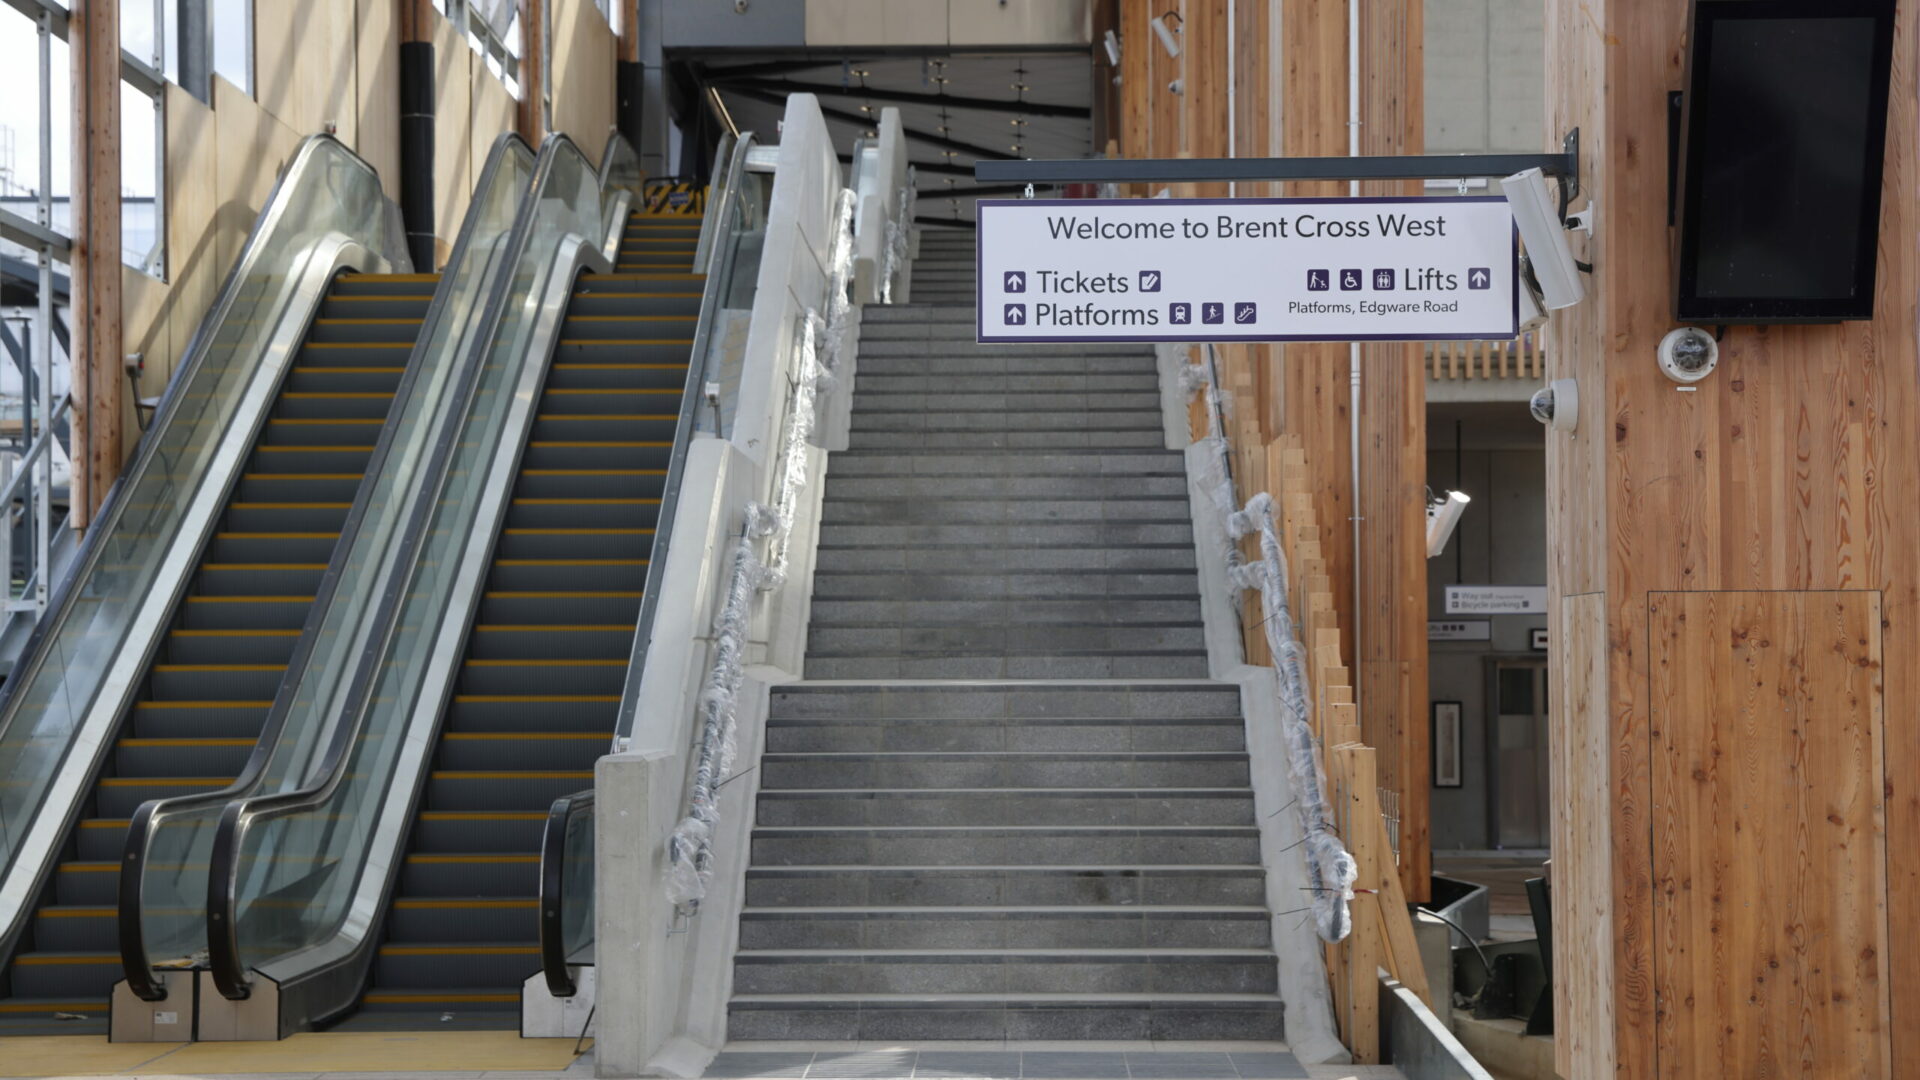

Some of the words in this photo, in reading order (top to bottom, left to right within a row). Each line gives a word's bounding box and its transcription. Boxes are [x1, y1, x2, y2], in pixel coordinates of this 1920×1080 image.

[1047, 216, 1175, 239] Welcome
[1182, 218, 1209, 239] to
[1217, 216, 1289, 239] Brent
[1294, 214, 1370, 238] Cross
[1376, 213, 1446, 237] West
[1037, 270, 1129, 294] Tickets
[1404, 267, 1458, 291] Lifts
[1036, 302, 1159, 326] Platforms
[1288, 300, 1356, 317] Platforms,
[1359, 300, 1421, 316] Edgware
[1423, 299, 1458, 313] Road
[1461, 591, 1478, 600] Way
[1461, 600, 1489, 609] Bicycle
[1490, 600, 1520, 609] parking
